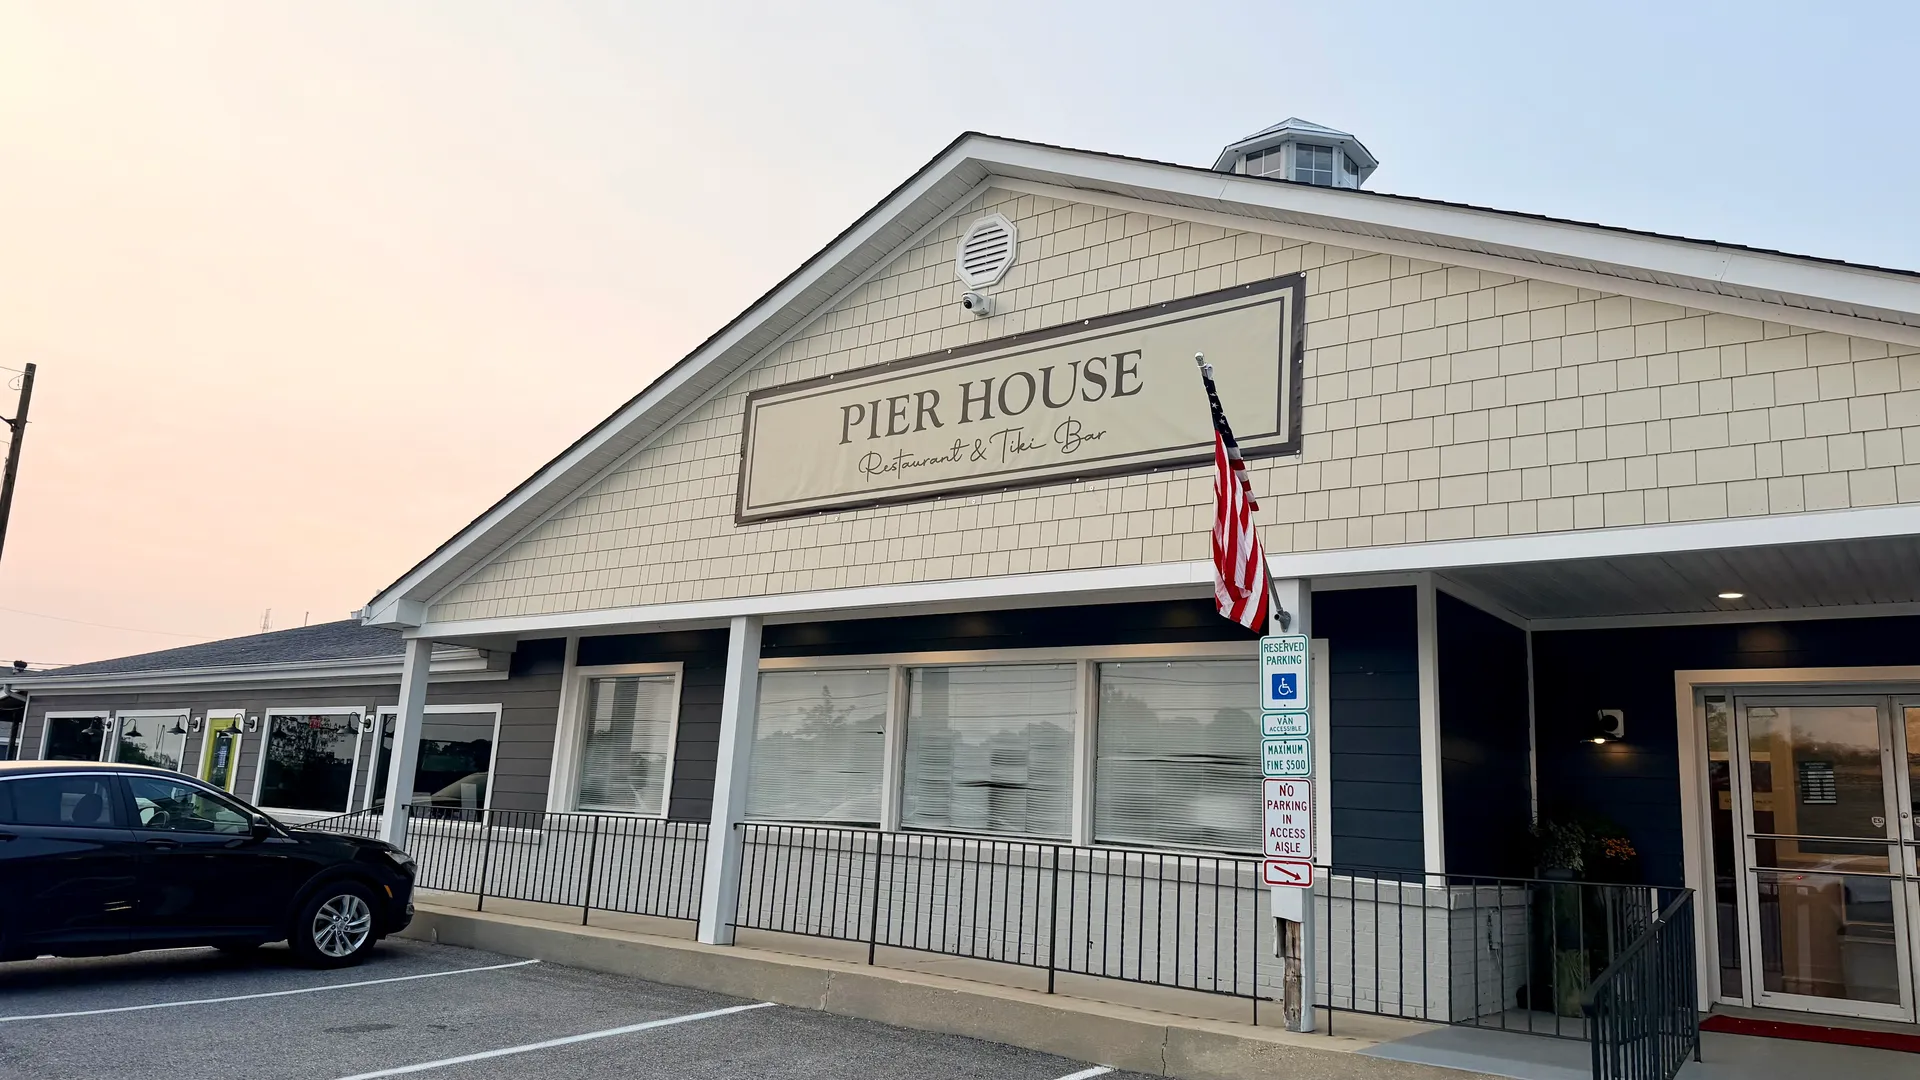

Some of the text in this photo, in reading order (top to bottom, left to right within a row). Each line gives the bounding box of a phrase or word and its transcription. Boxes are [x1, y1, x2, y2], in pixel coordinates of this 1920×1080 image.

[839, 349, 1144, 445] PIER HOUSE
[858, 416, 1107, 482] Restaurant & Tiki Bar
[1263, 642, 1304, 653] RESERVED
[1266, 655, 1302, 665] PARKING
[1277, 717, 1294, 725] VAN
[1268, 744, 1303, 754] MAXIMUM
[1267, 759, 1306, 770] FINE $500
[1279, 785, 1294, 797] NO
[1267, 800, 1307, 812] PARKING
[1282, 814, 1292, 824] IN
[1270, 827, 1306, 839] ACCESS
[1274, 841, 1301, 853] AISLE
